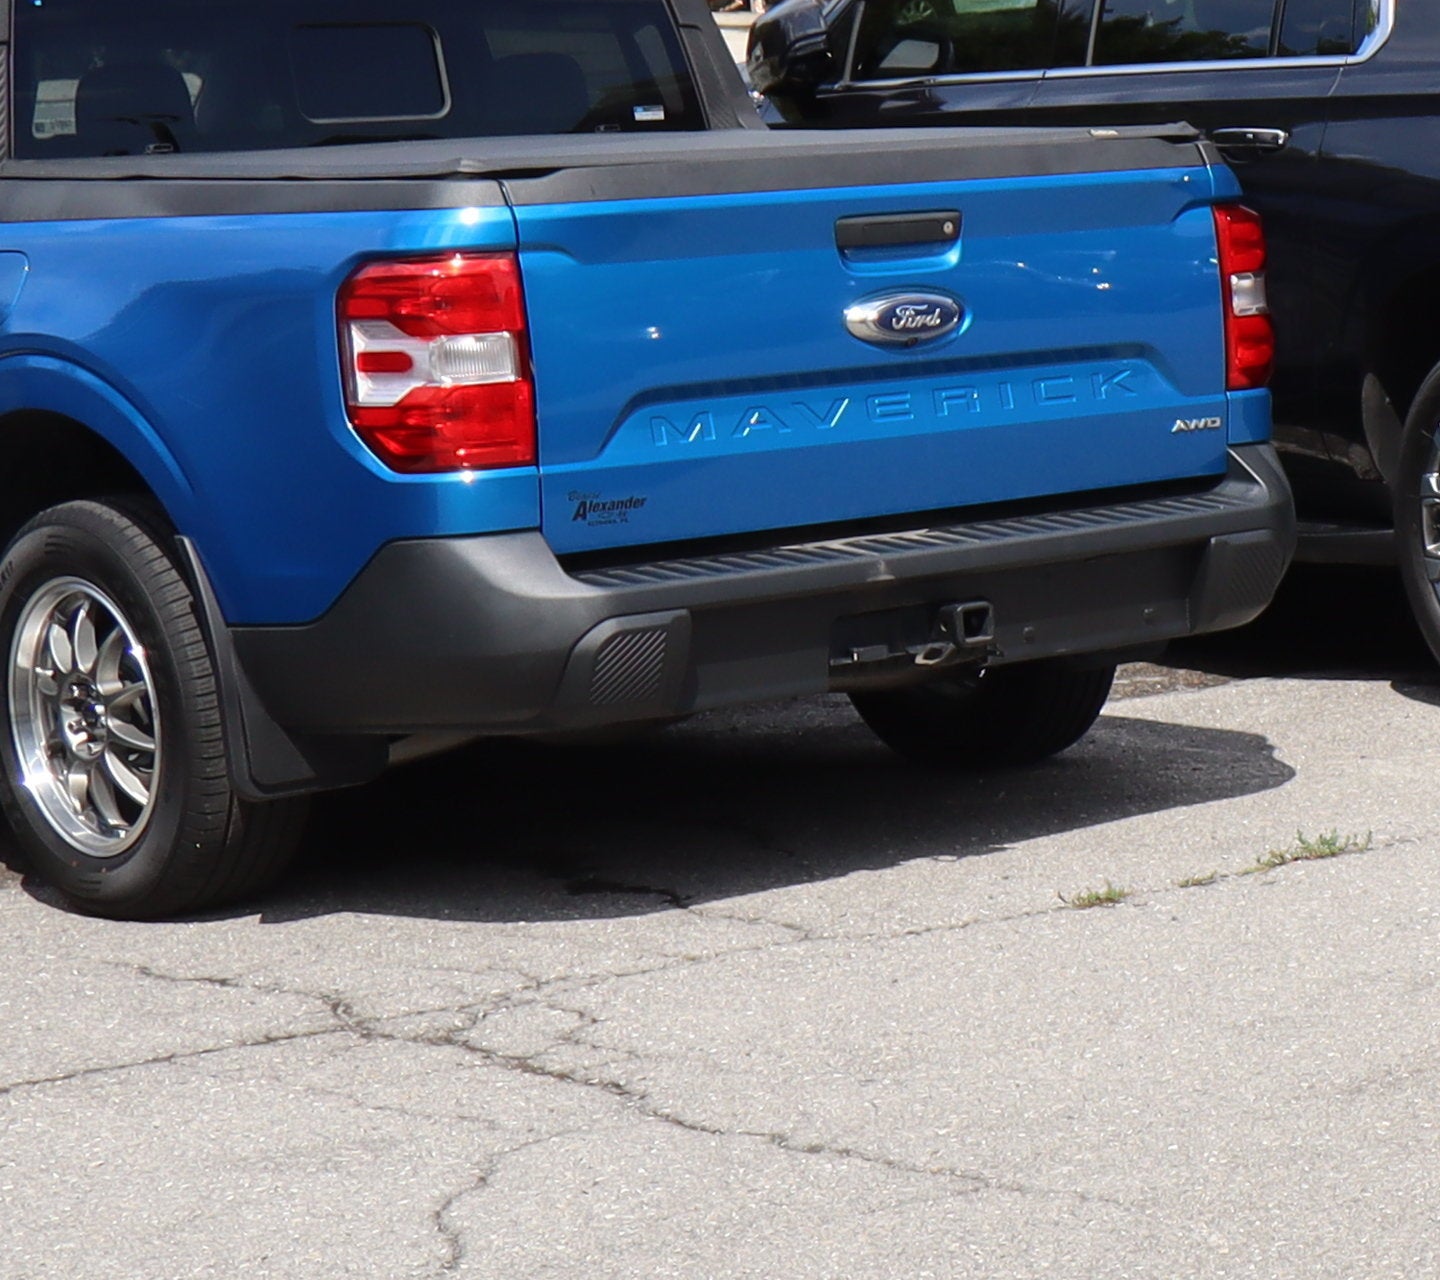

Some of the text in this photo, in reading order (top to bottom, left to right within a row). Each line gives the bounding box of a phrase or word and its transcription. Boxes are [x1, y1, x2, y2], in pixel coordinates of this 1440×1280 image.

[892, 304, 941, 330] Ford
[649, 367, 1138, 447] MAVERICK
[1171, 416, 1221, 433] AWD
[571, 495, 647, 521] Alexander
